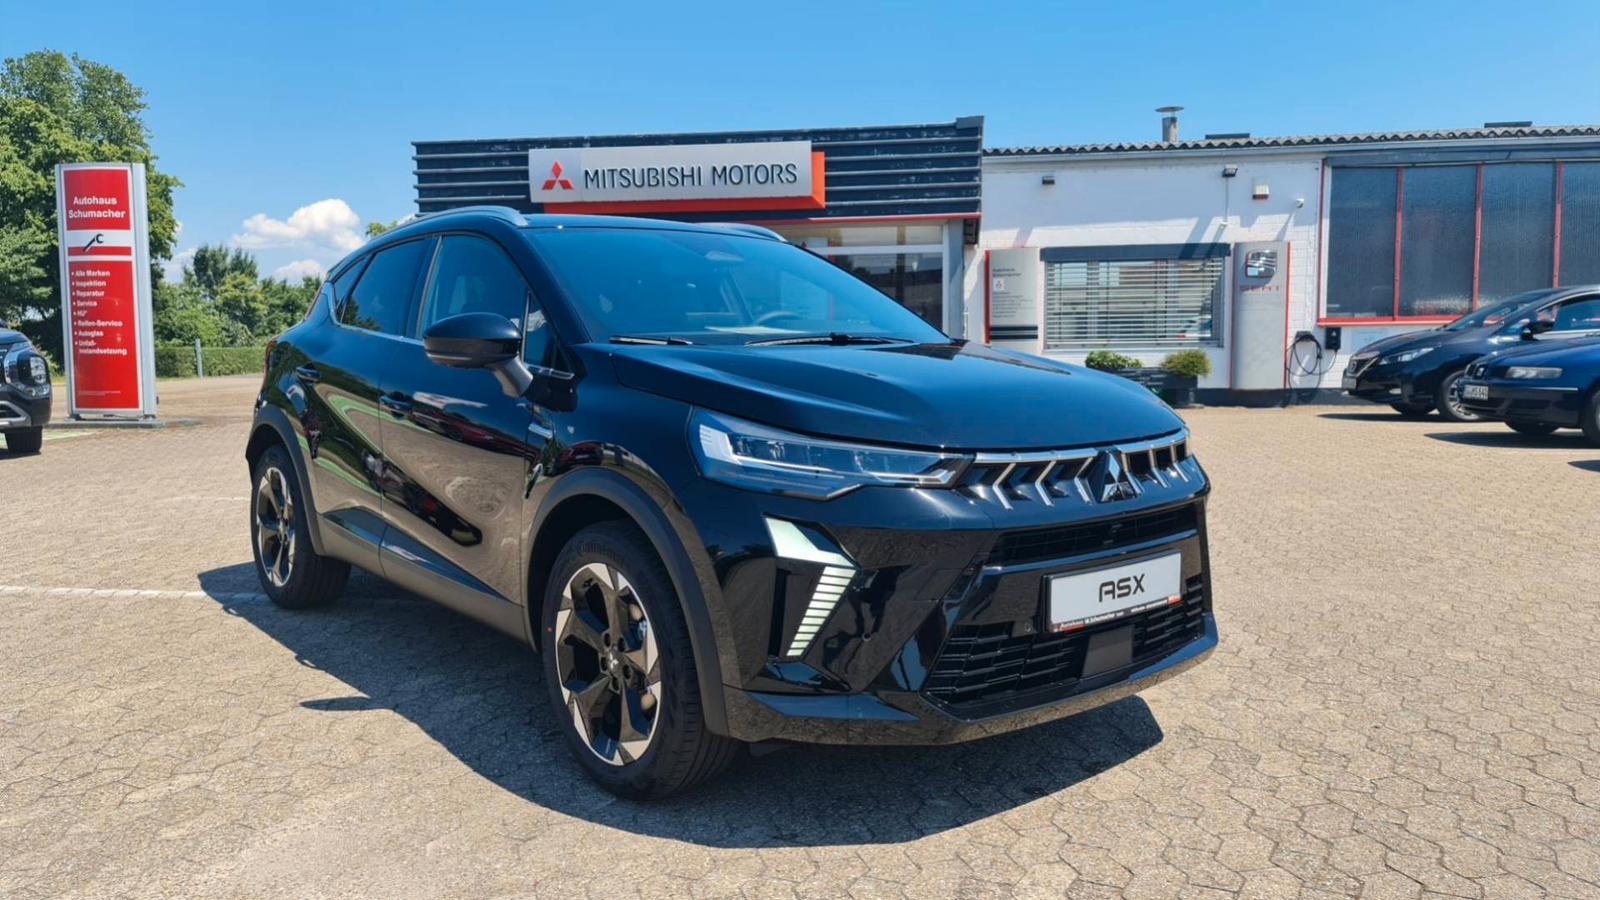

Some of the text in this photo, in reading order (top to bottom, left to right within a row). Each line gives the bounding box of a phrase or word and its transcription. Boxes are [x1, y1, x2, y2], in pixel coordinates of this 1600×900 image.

[584, 163, 798, 189] MITSUBISHI MOTORS
[73, 196, 117, 205] Autohaus
[68, 209, 126, 219] Schumacher
[75, 280, 107, 288] Inspektion
[76, 290, 105, 298] Reparatur
[79, 330, 104, 338] Autoglas
[79, 348, 128, 356] Instandsetzung
[1098, 573, 1145, 602] ASX
